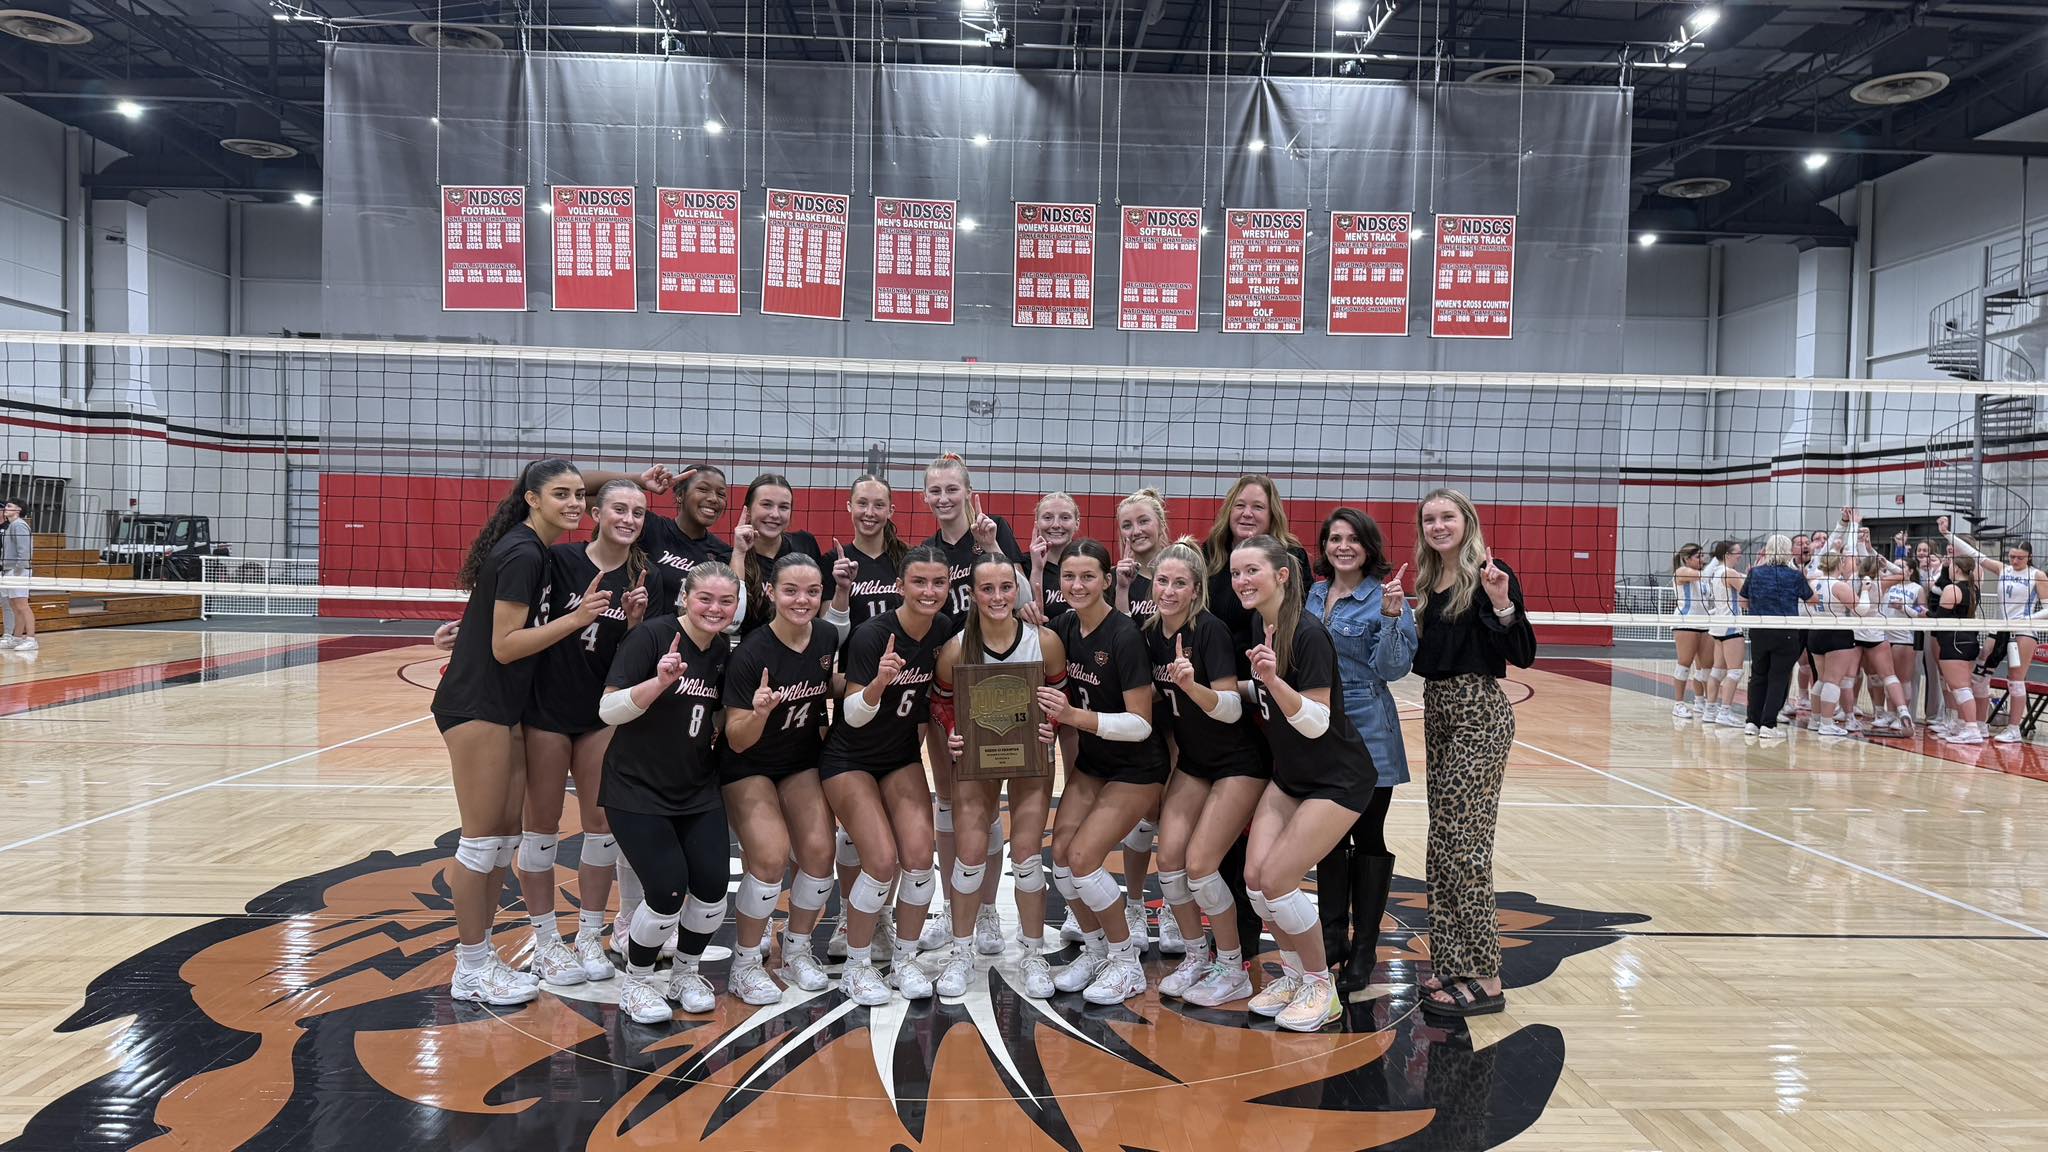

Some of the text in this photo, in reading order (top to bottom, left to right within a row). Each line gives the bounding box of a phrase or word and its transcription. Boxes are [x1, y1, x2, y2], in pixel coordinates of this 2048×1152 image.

[468, 189, 522, 206] NDSCS
[578, 190, 632, 206] NDSCS
[684, 193, 737, 209] NDSCS
[793, 195, 845, 215] NDSCS
[462, 207, 507, 215] FOOTBALL
[568, 207, 618, 215] VOLLEYBALL
[674, 209, 724, 218] VOLLEYBALL
[769, 210, 845, 224] MEN'S BASKETBALL
[901, 202, 952, 220] NDSCS
[1041, 207, 1092, 223] NDSCS
[1147, 210, 1198, 227] NDSCS
[877, 219, 952, 229] MEN'S BASKETBALL
[1018, 224, 1092, 233] WOMEN'S BASKETBALL
[1251, 213, 1302, 229] NDSCS
[1357, 216, 1407, 232] NDSCS
[1461, 219, 1512, 235] NDSCS
[1140, 227, 1182, 236] SOFTBALL
[1242, 230, 1289, 238] WRESTLING
[1345, 233, 1396, 241] MEN'S TRACK
[1443, 235, 1506, 244] WOMEN'S TRACK
[1249, 286, 1279, 294] TENNIS
[1352, 297, 1373, 305] CROSS
[1436, 300, 1461, 308] WOMEN'S
[1483, 301, 1509, 309] COUNTRY
[850, 579, 898, 597] Wildcat
[949, 584, 971, 615] 16
[867, 600, 886, 618] 11
[581, 622, 600, 652] 4
[778, 680, 827, 703] Wildcats
[896, 689, 916, 717] 6
[1164, 689, 1180, 717] 7
[1258, 688, 1270, 720] 5
[688, 704, 705, 738] 8
[781, 702, 811, 730] 14
[1014, 712, 1027, 722] 13
